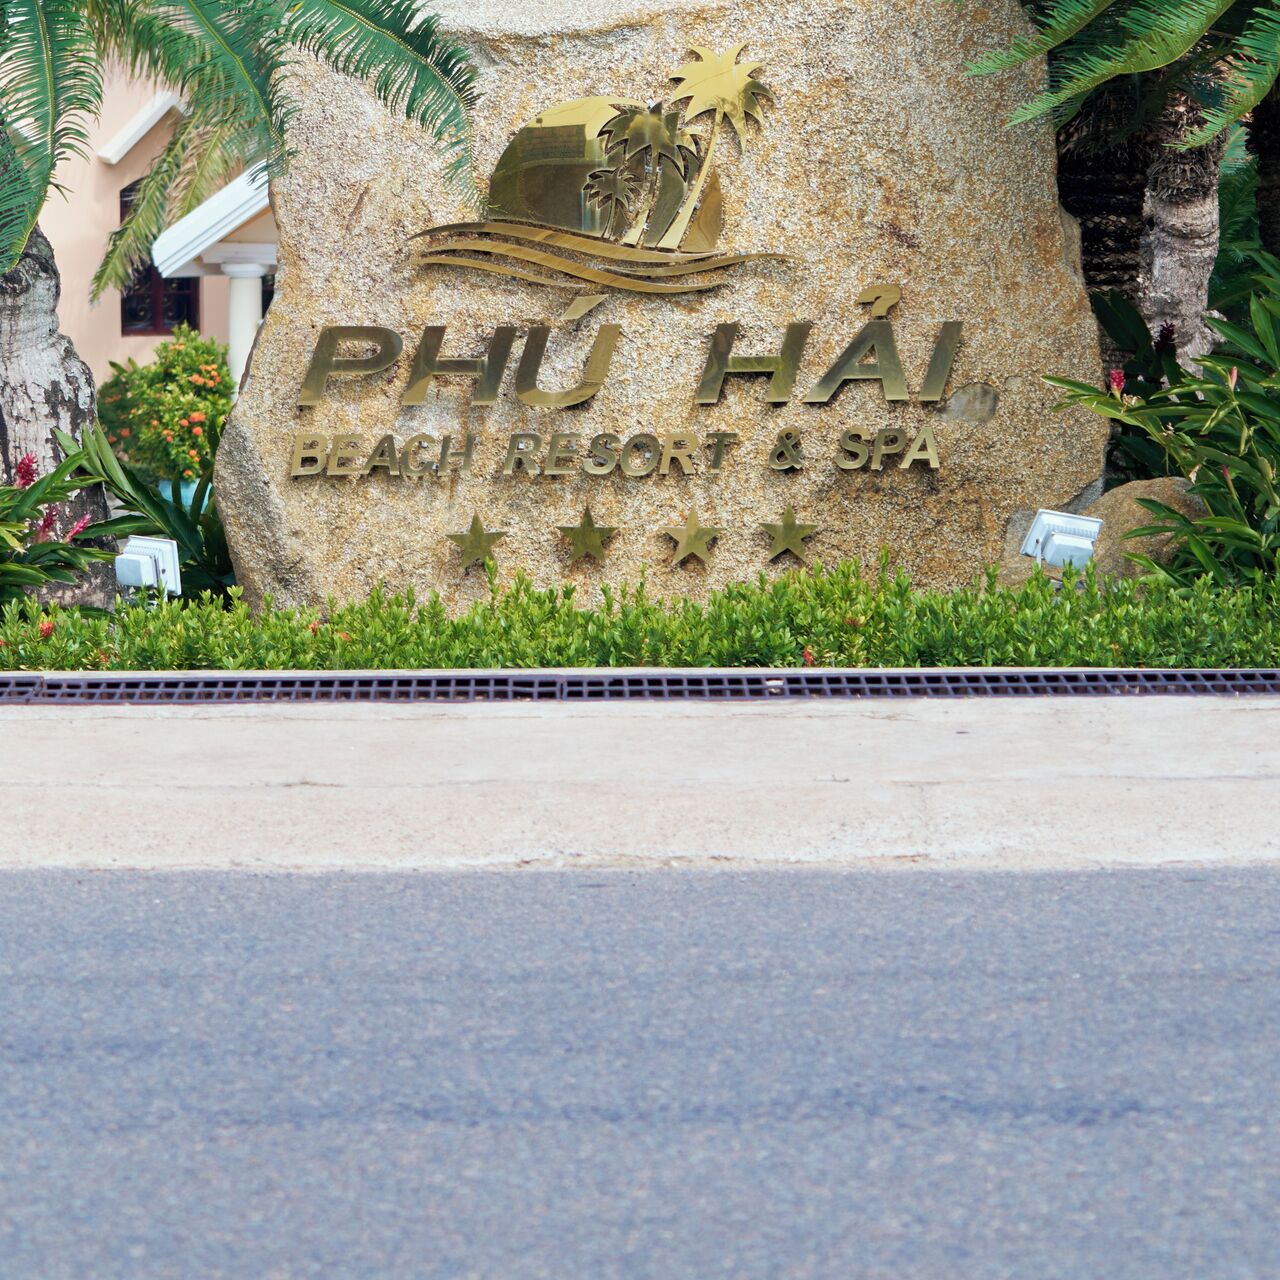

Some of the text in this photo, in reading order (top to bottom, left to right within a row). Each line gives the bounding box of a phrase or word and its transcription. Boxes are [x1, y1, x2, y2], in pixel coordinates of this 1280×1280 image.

[297, 284, 964, 408] PHÚ HẢI
[291, 427, 941, 478] BEACH RESORT & SPA
